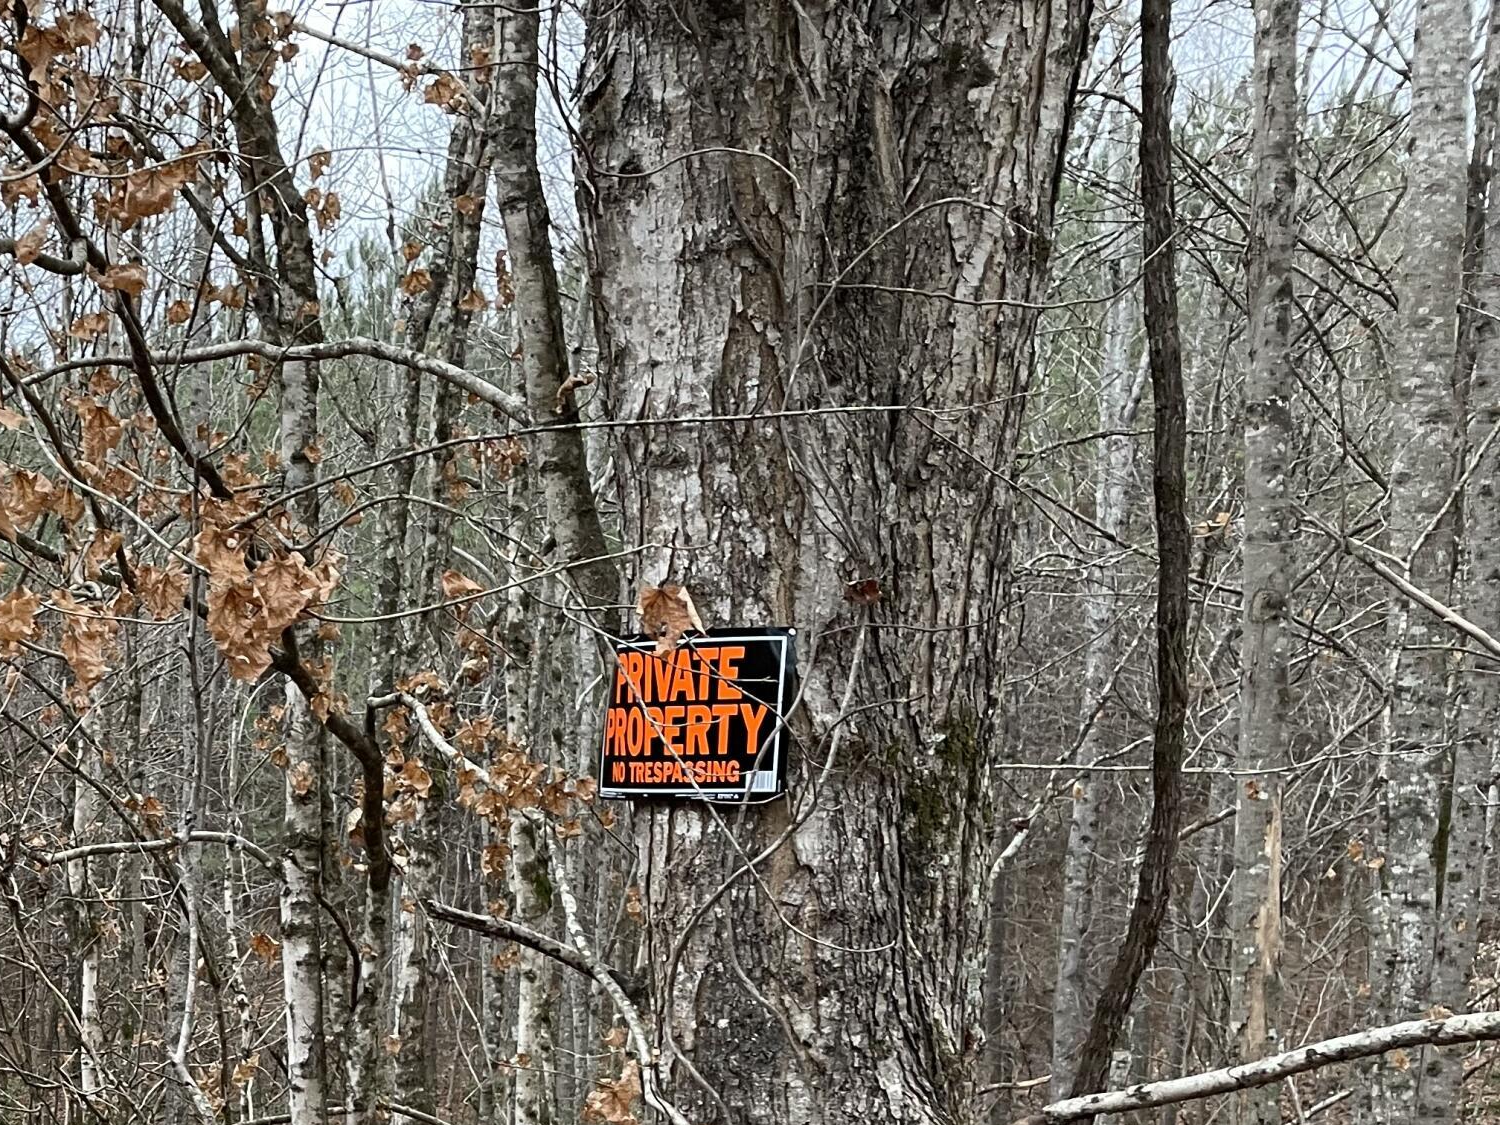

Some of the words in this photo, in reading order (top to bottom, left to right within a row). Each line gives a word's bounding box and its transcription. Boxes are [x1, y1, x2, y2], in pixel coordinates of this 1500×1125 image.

[616, 646, 746, 704] PRIVATE
[605, 703, 768, 757] PROPERTY
[612, 761, 626, 783] NO
[629, 760, 740, 783] TRESPASSING
